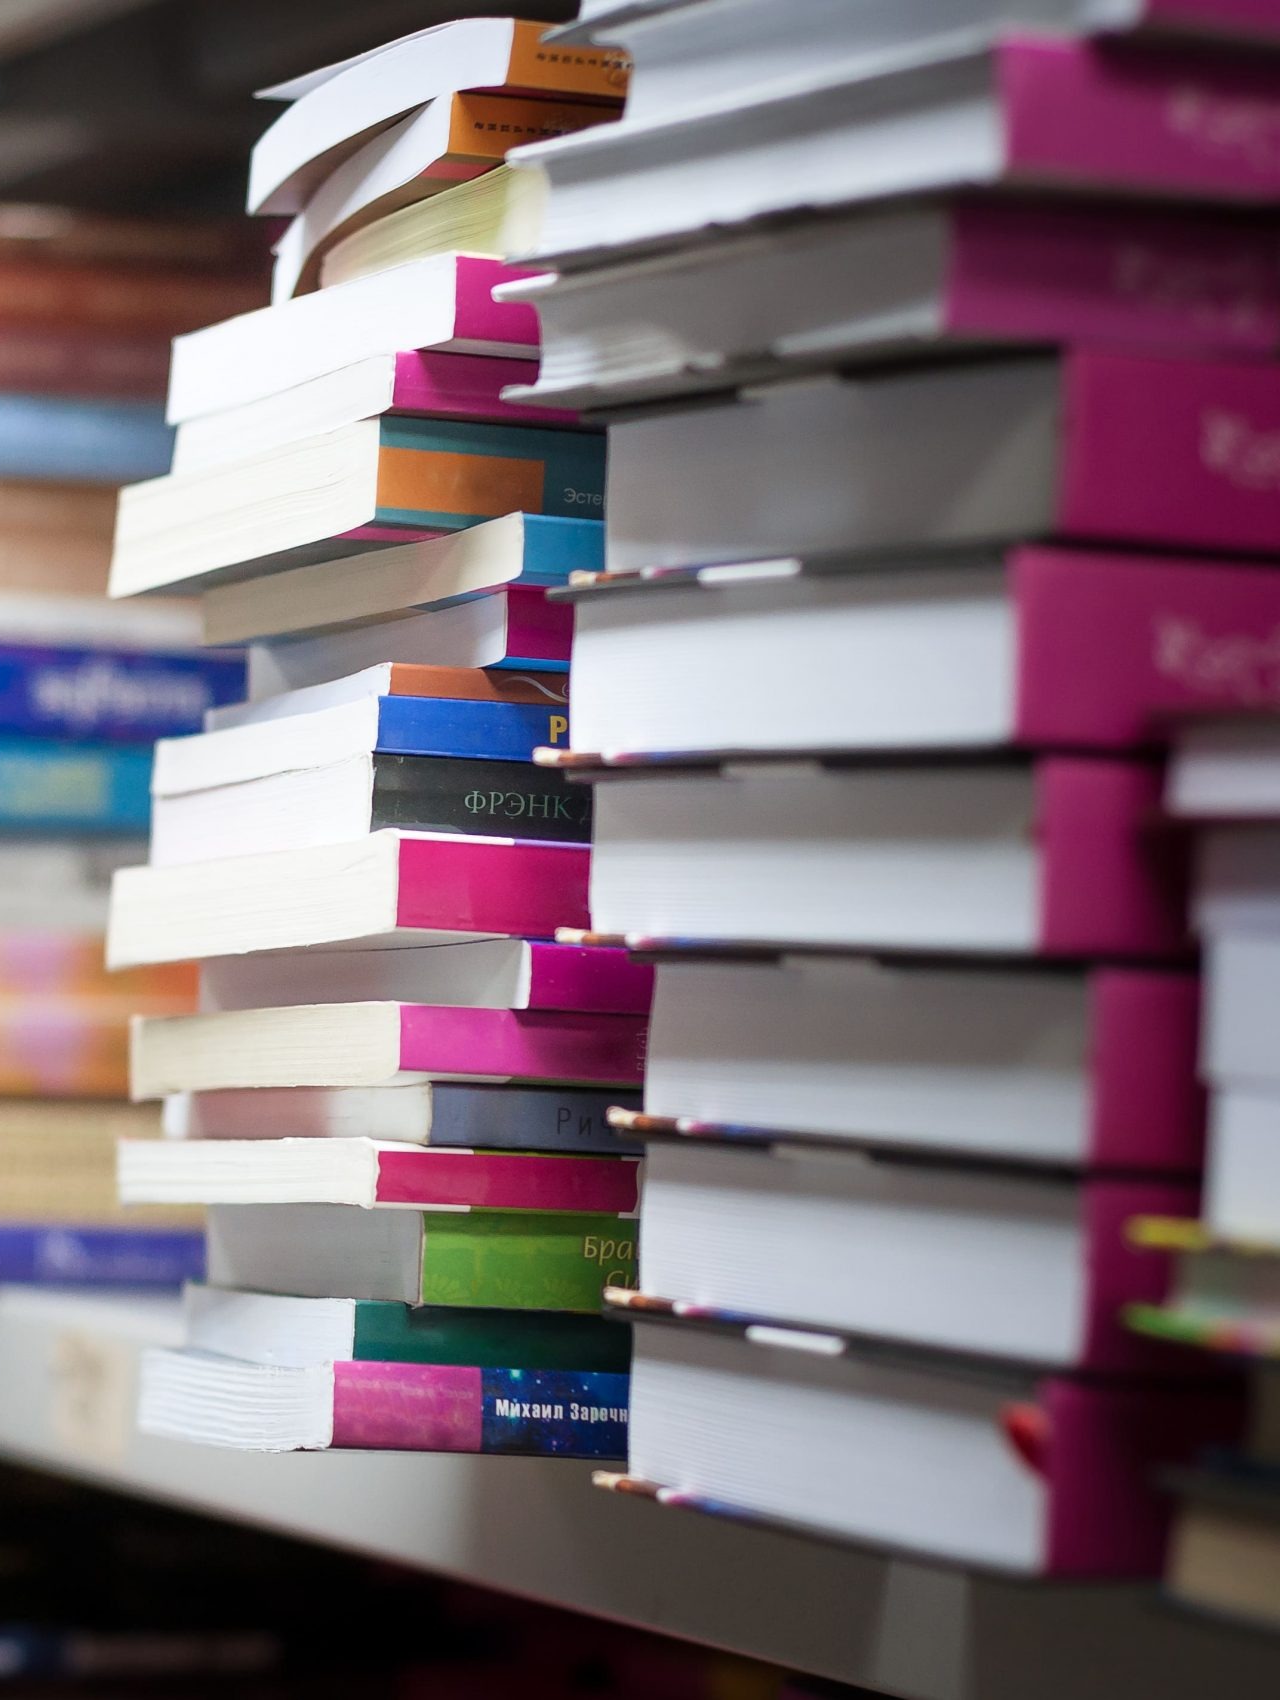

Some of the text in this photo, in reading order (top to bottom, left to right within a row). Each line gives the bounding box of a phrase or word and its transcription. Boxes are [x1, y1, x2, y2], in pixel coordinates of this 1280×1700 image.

[563, 487, 606, 506] Эсте
[464, 790, 572, 820] ФРЭНК
[583, 1235, 638, 1267] Бра
[495, 1398, 564, 1420] Михаил
